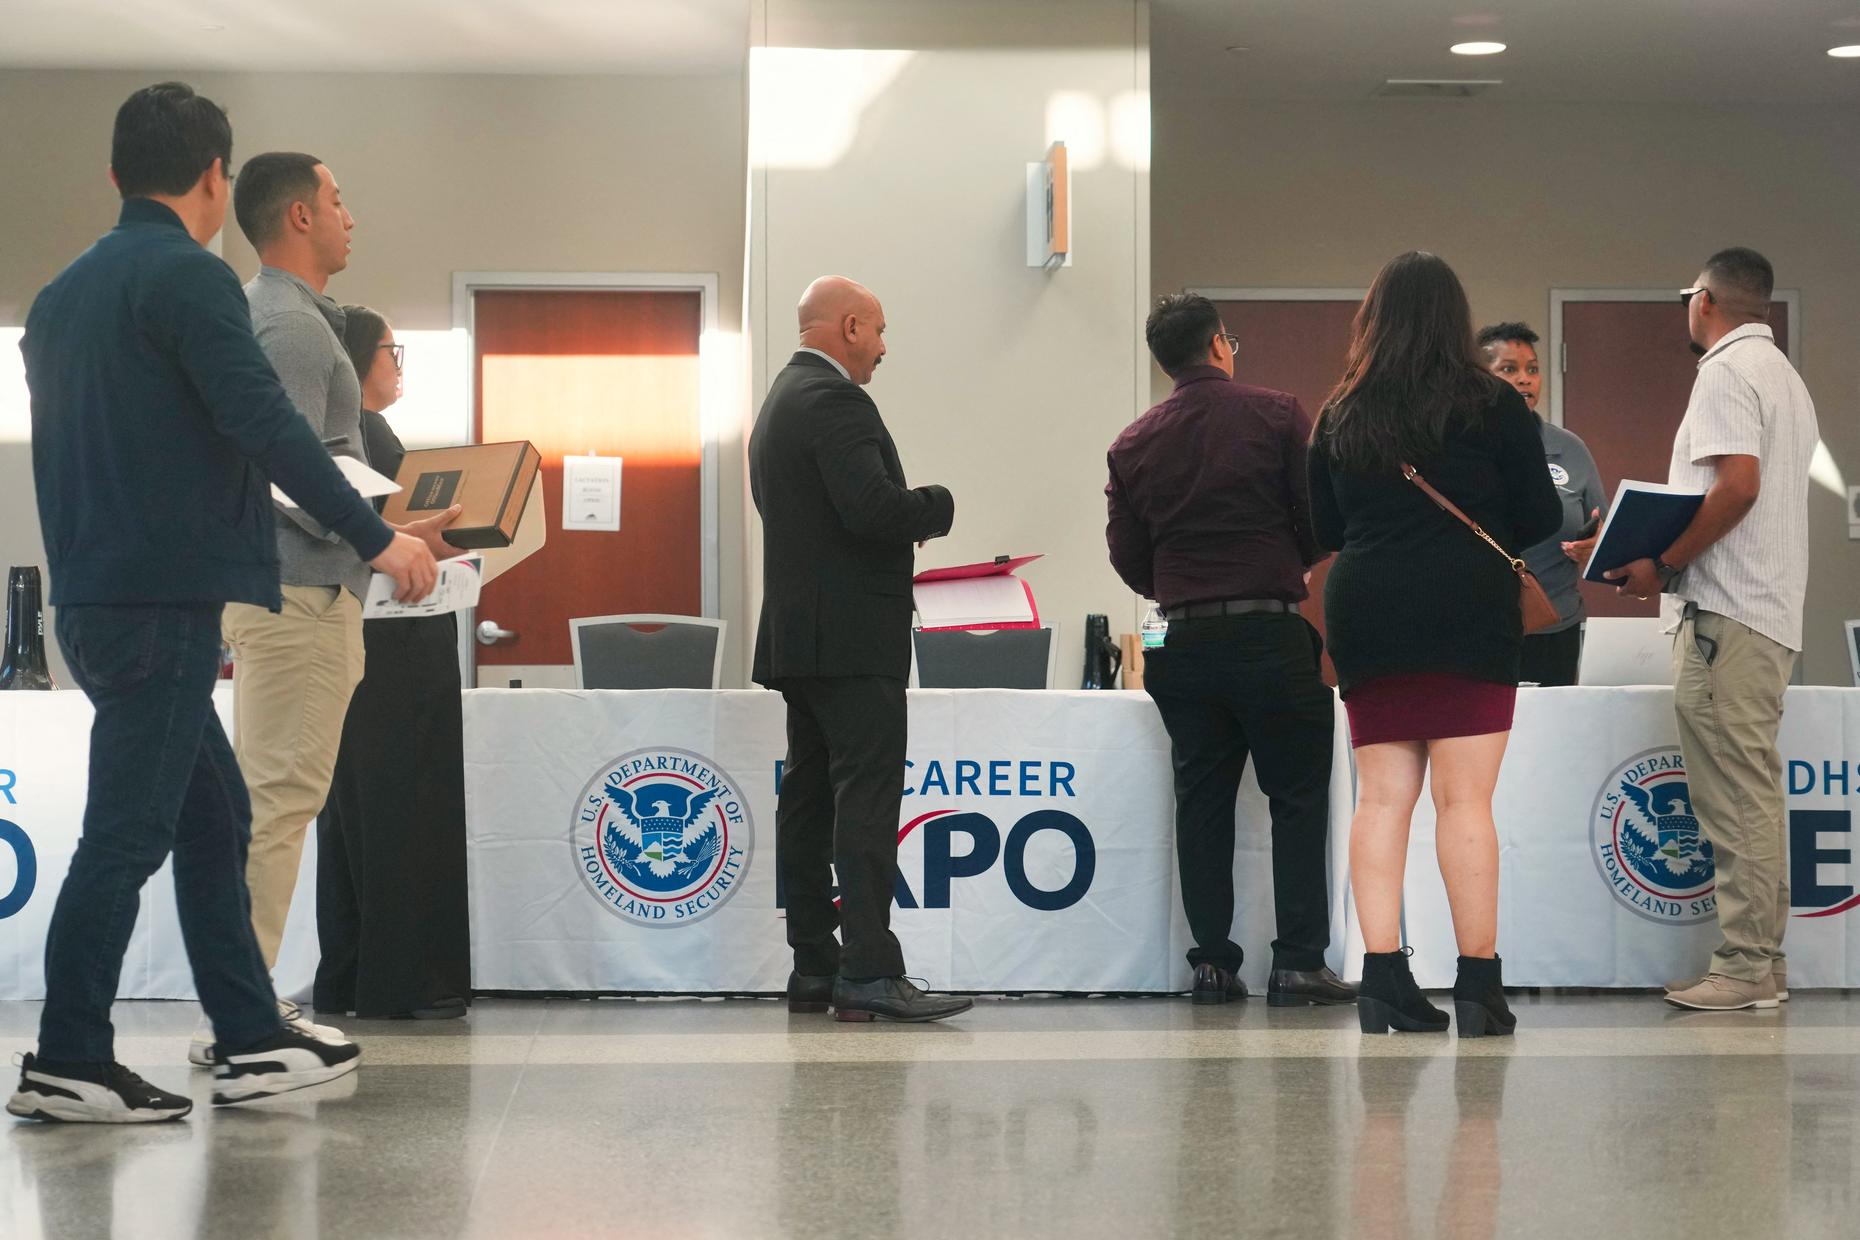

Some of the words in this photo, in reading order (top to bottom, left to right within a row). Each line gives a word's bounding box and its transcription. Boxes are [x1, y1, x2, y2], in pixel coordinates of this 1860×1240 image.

[581, 795, 605, 822] U.S.
[607, 756, 732, 799] DEPARTMENT
[725, 801, 744, 824] OF
[1600, 792, 1622, 820] U.S.
[1624, 755, 1684, 783] DEPAR
[1788, 760, 1860, 796] DH
[581, 846, 666, 919] HOMELAND
[675, 845, 744, 919] SECURITY
[775, 809, 1097, 912] PO
[1600, 844, 1682, 916] HOMELAND
